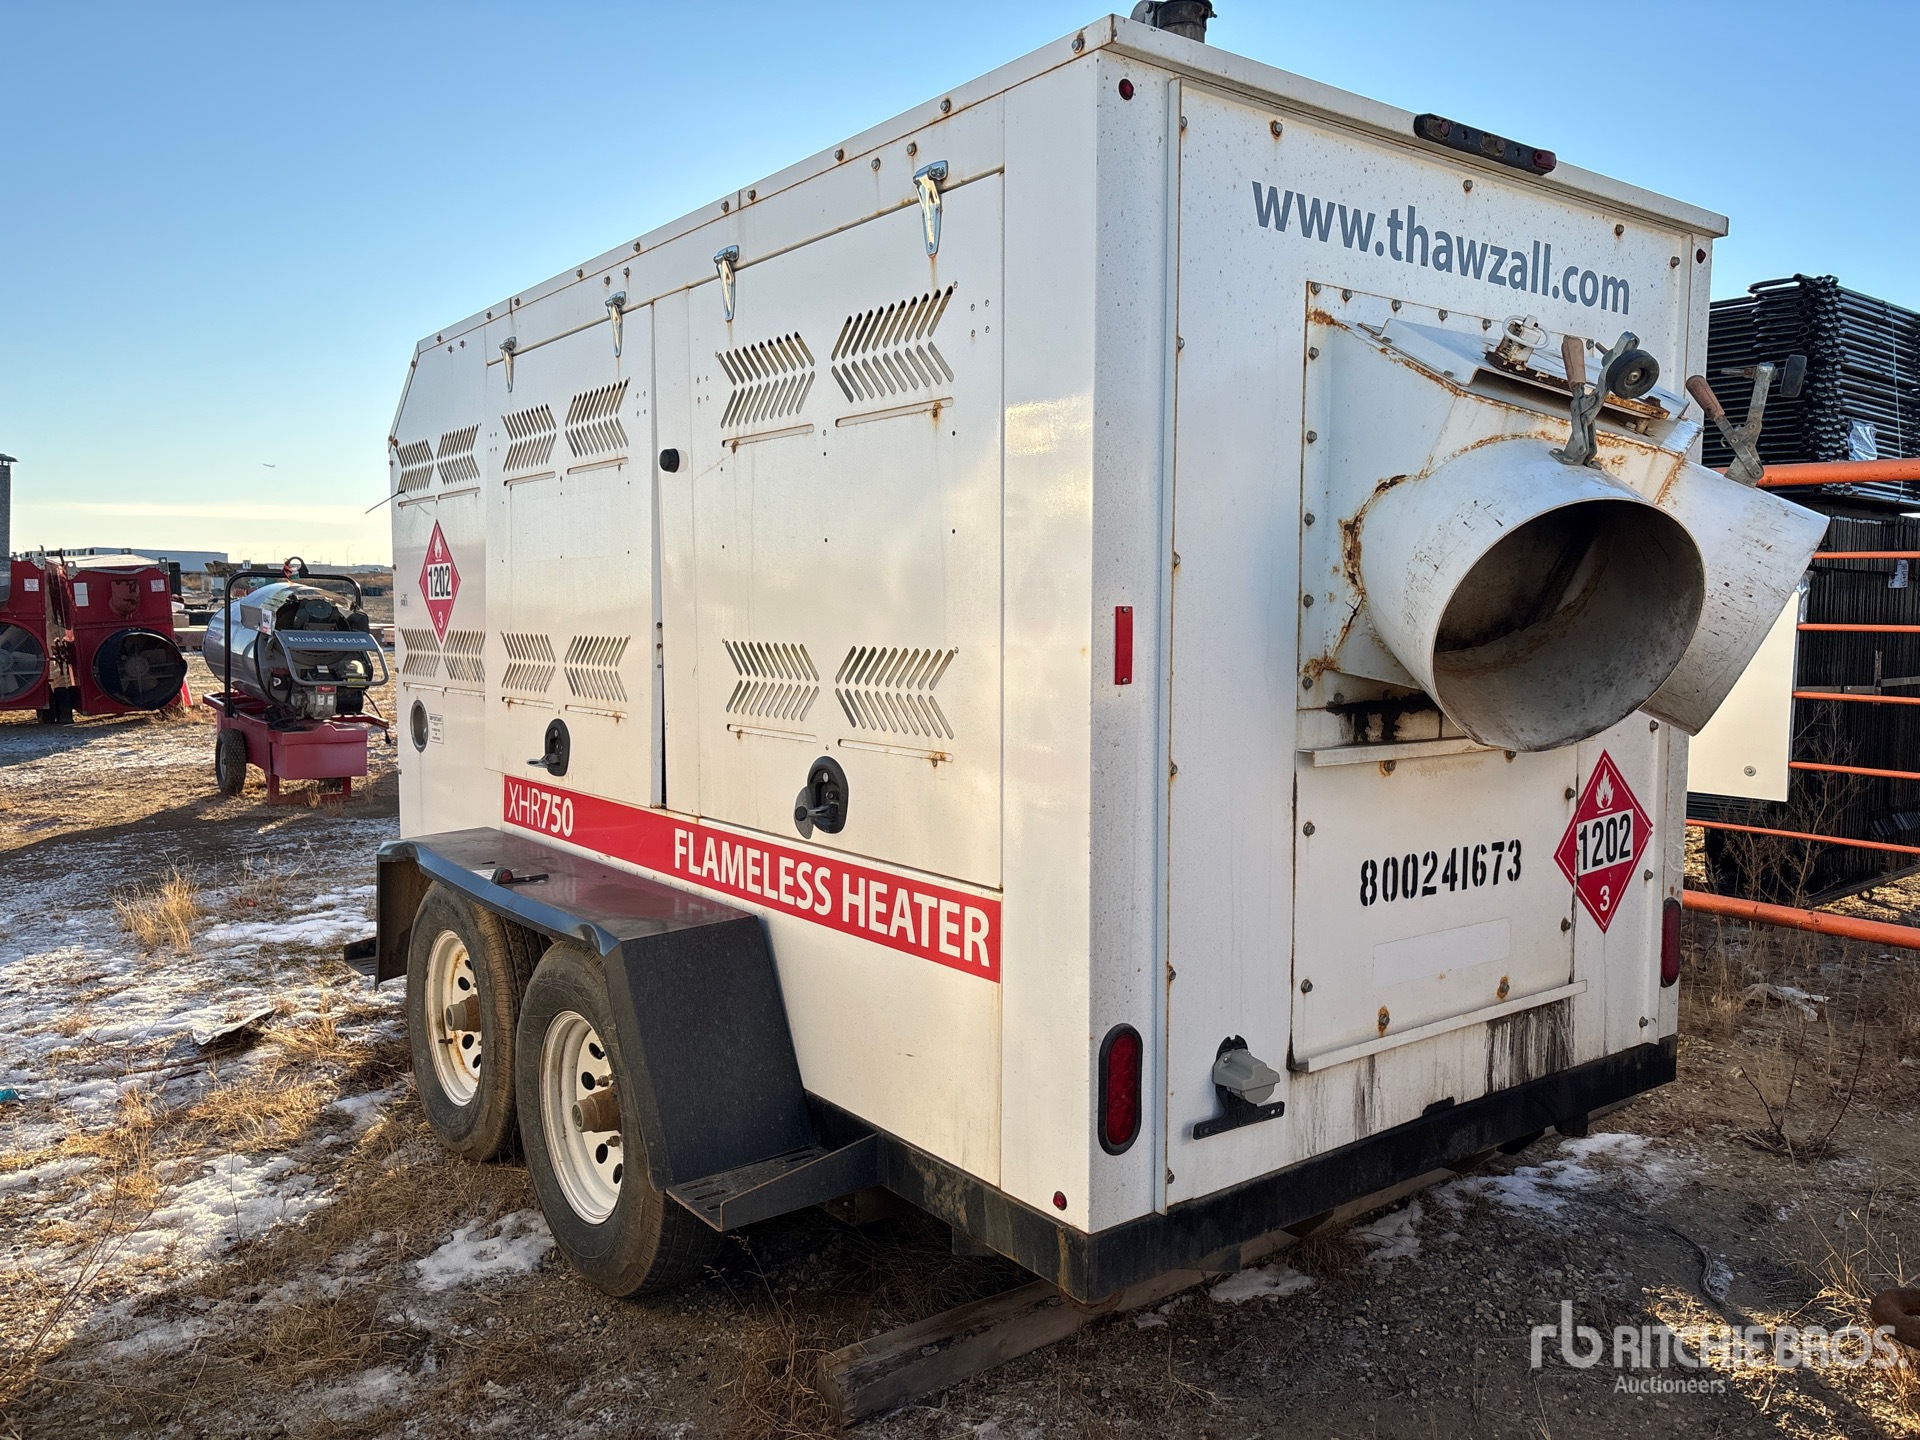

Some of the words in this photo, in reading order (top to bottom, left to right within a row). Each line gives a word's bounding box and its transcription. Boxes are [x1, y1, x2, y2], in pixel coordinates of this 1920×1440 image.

[1251, 181, 1631, 316] www.thawzall.com
[428, 565, 451, 597] 1202
[438, 611, 443, 629] 3
[508, 782, 574, 837] XHR750
[1578, 814, 1632, 871] 1202
[674, 828, 832, 916] FLAMELESS
[842, 873, 991, 968] HEATER
[1360, 839, 1522, 907] 800241673
[1599, 885, 1610, 911] 3
